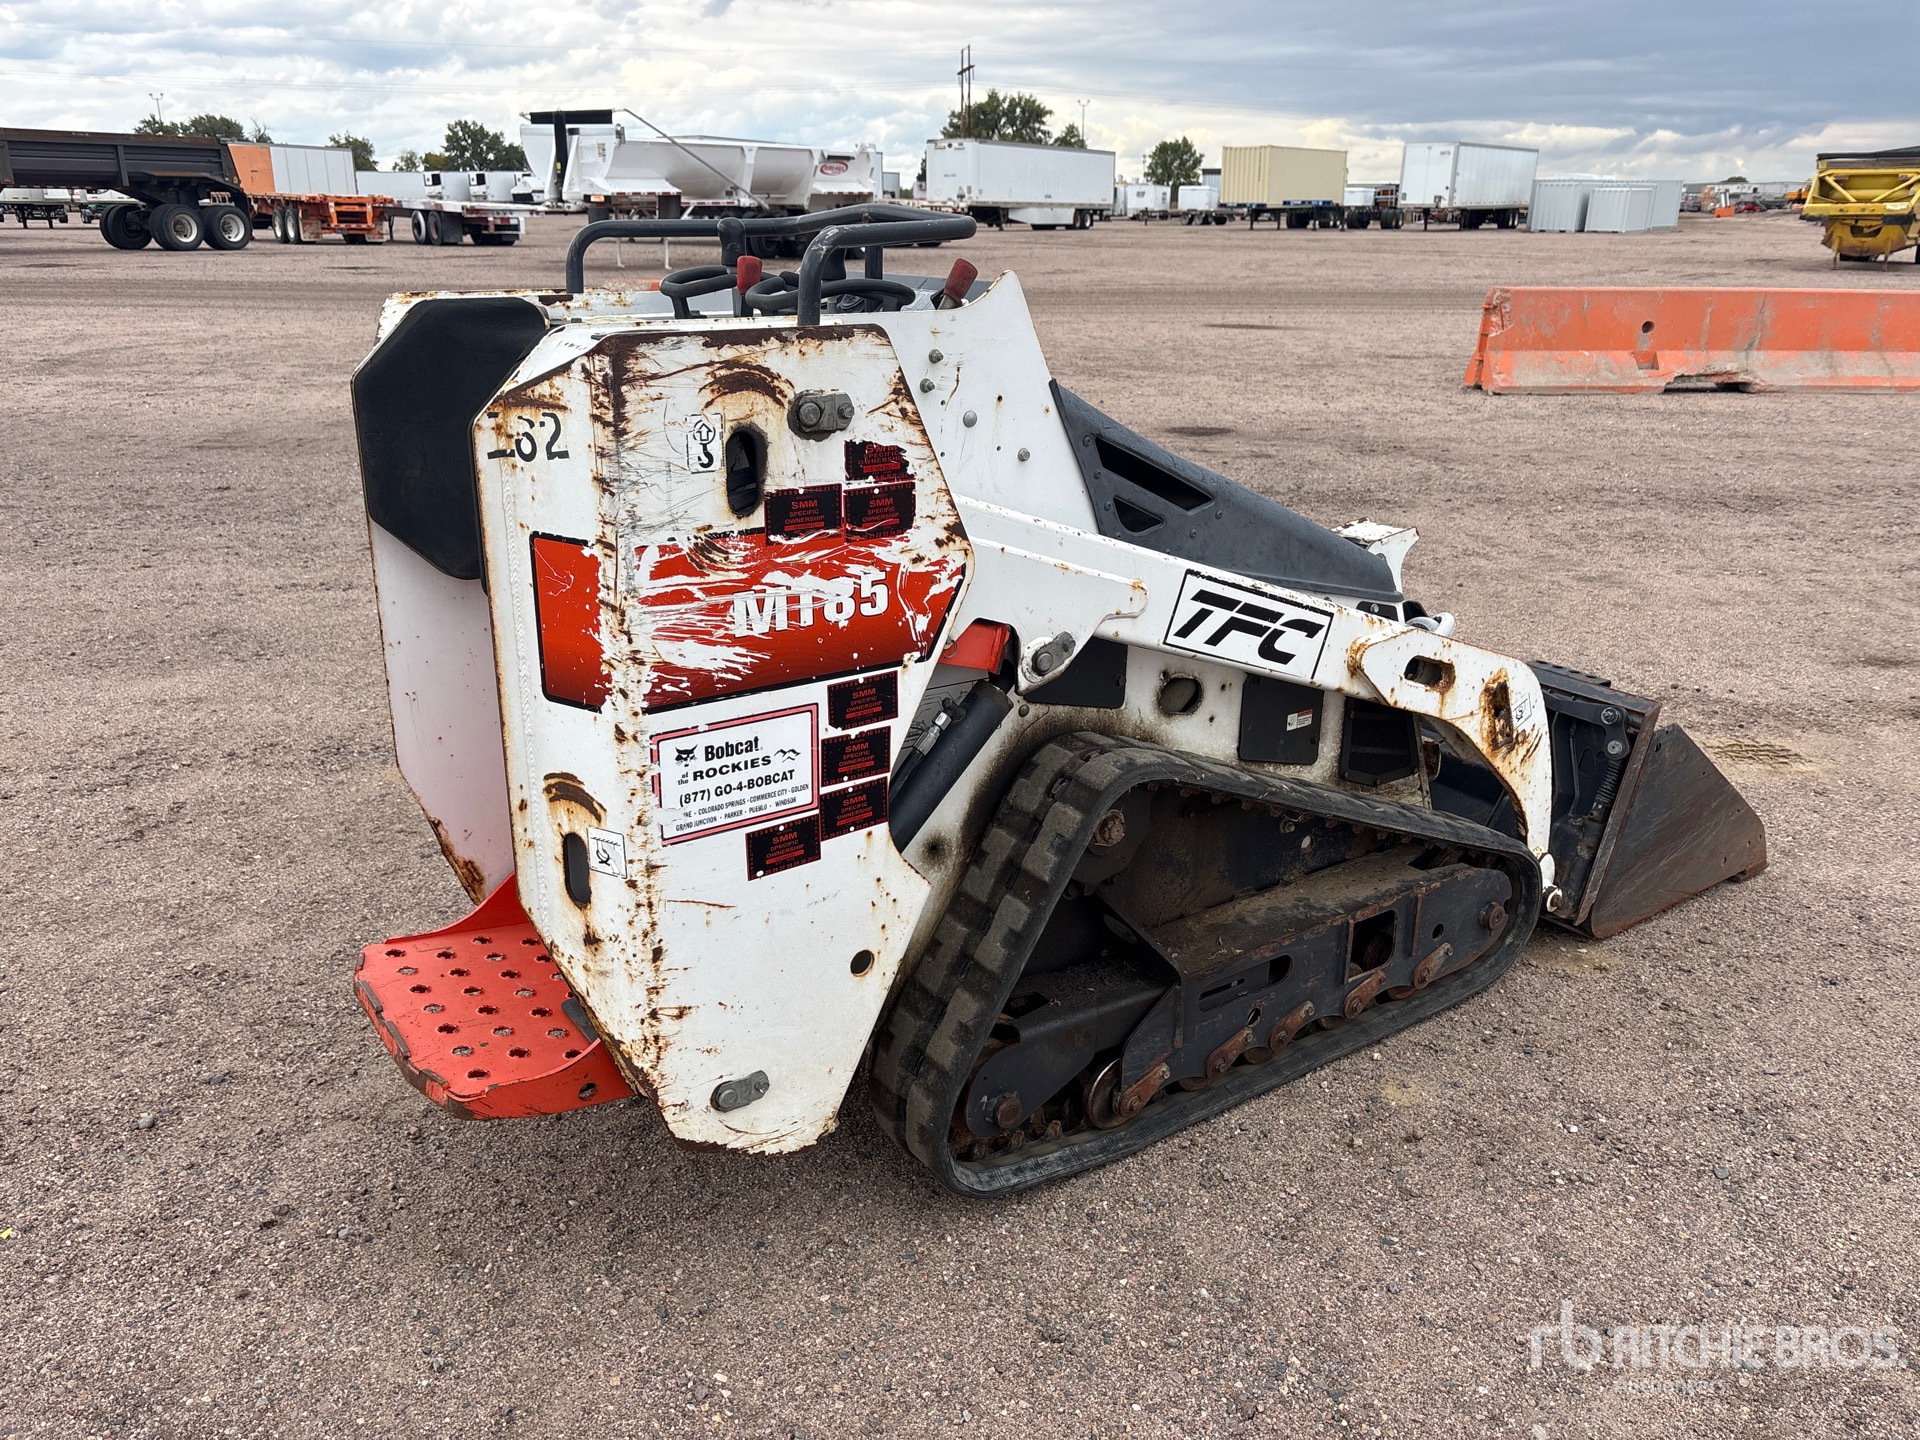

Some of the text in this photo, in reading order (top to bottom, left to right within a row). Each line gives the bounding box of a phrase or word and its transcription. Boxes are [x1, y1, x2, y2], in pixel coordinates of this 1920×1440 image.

[791, 500, 818, 509] SMM
[869, 497, 893, 507] SMM
[1173, 589, 1326, 665] TFC
[852, 688, 876, 698] SMM
[704, 736, 760, 762] Bobcat
[845, 742, 869, 752] SMM
[692, 755, 772, 781] ROCKIES
[679, 769, 795, 807] (877) GO-4-BOBCAT
[698, 803, 725, 816] COLORADO
[724, 798, 746, 809] SPRINGS
[749, 791, 777, 804] COMMERCE
[777, 788, 788, 797] CITY
[790, 783, 809, 794] GOLDEN
[843, 794, 867, 806] SMM
[675, 796, 797, 832] GRAND JUNCTION PARKER PUEBLO WINDSOR
[772, 832, 797, 844] SMM
